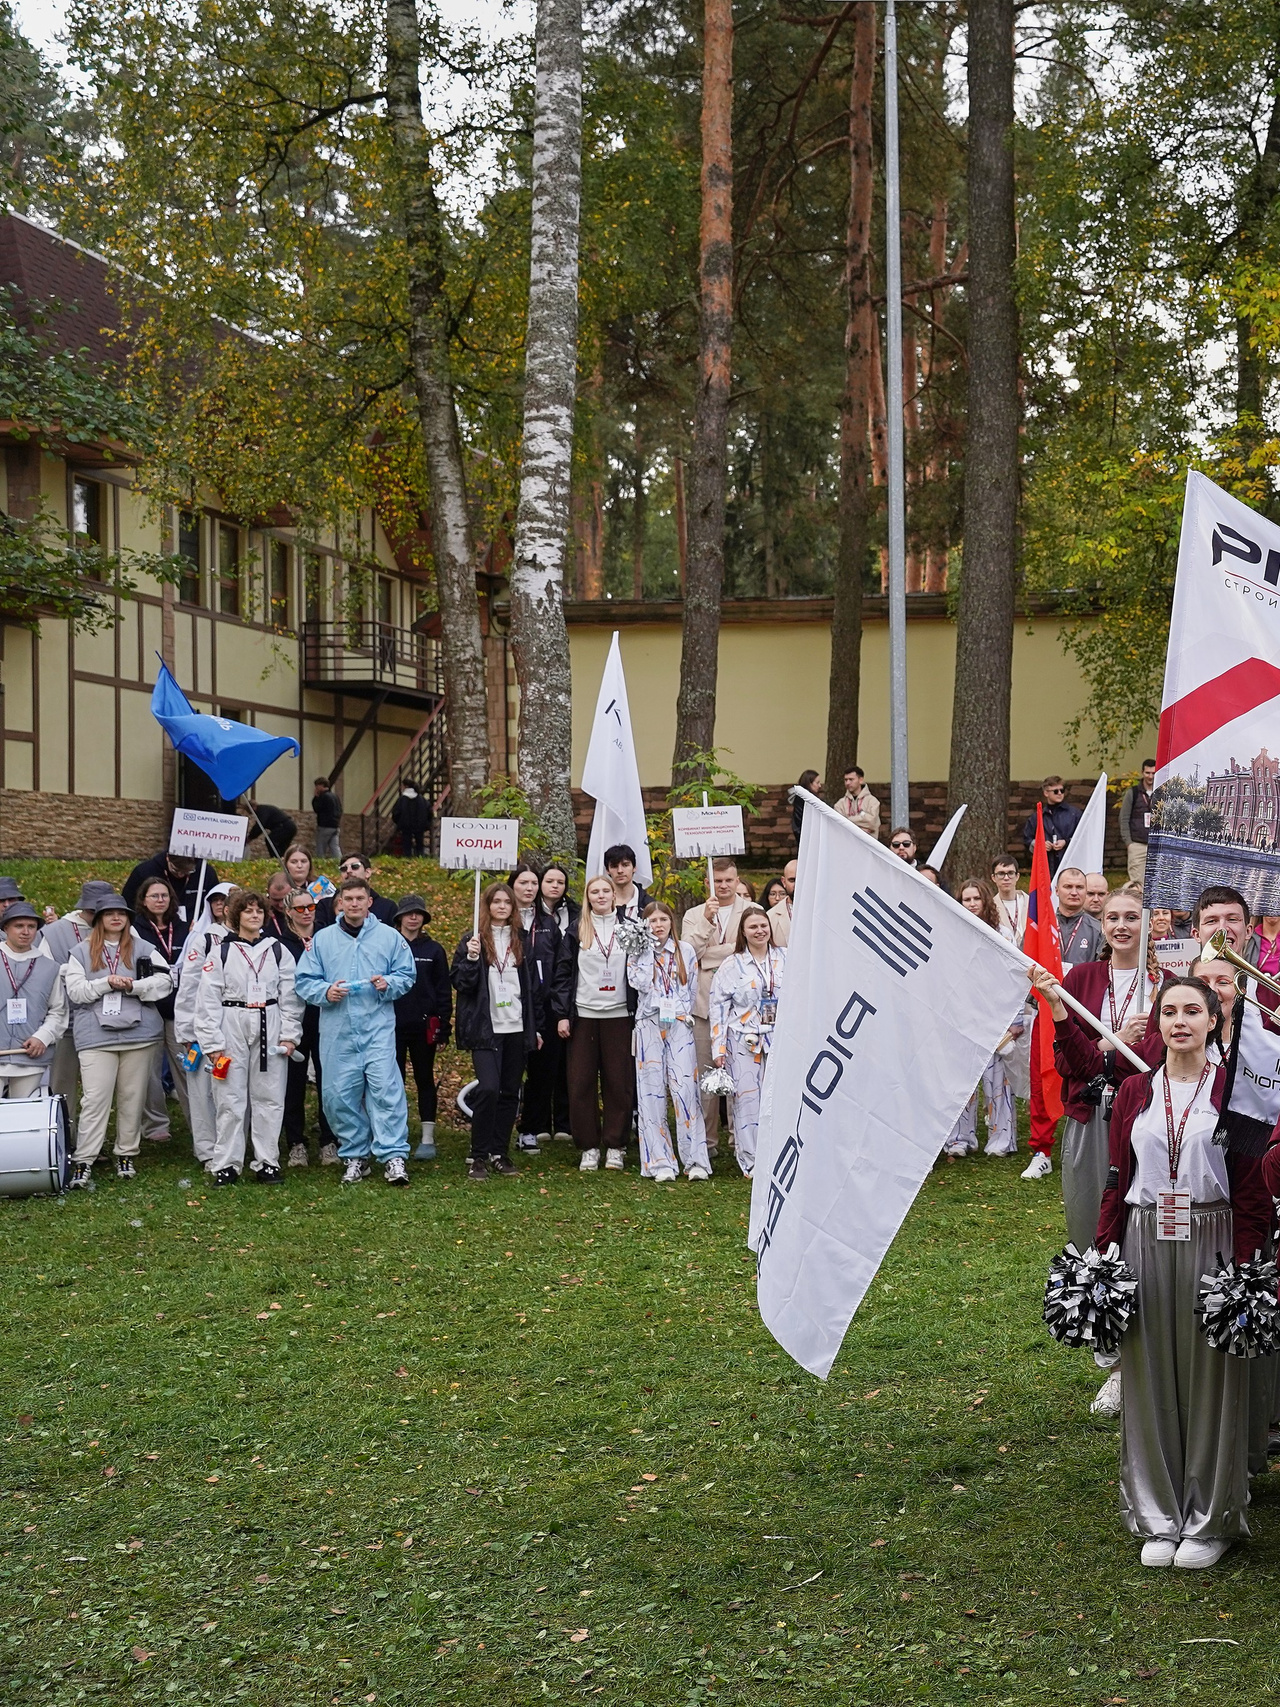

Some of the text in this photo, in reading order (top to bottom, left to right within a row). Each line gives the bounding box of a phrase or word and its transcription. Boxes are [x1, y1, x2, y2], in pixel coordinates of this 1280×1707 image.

[197, 815, 219, 824] CAPITAL
[452, 822, 507, 830] КОЛДИ
[177, 828, 240, 842] КАПИТАЛ ГРУП
[456, 838, 502, 850] КОЛДИ
[1160, 959, 1183, 968] ТРОЙ
